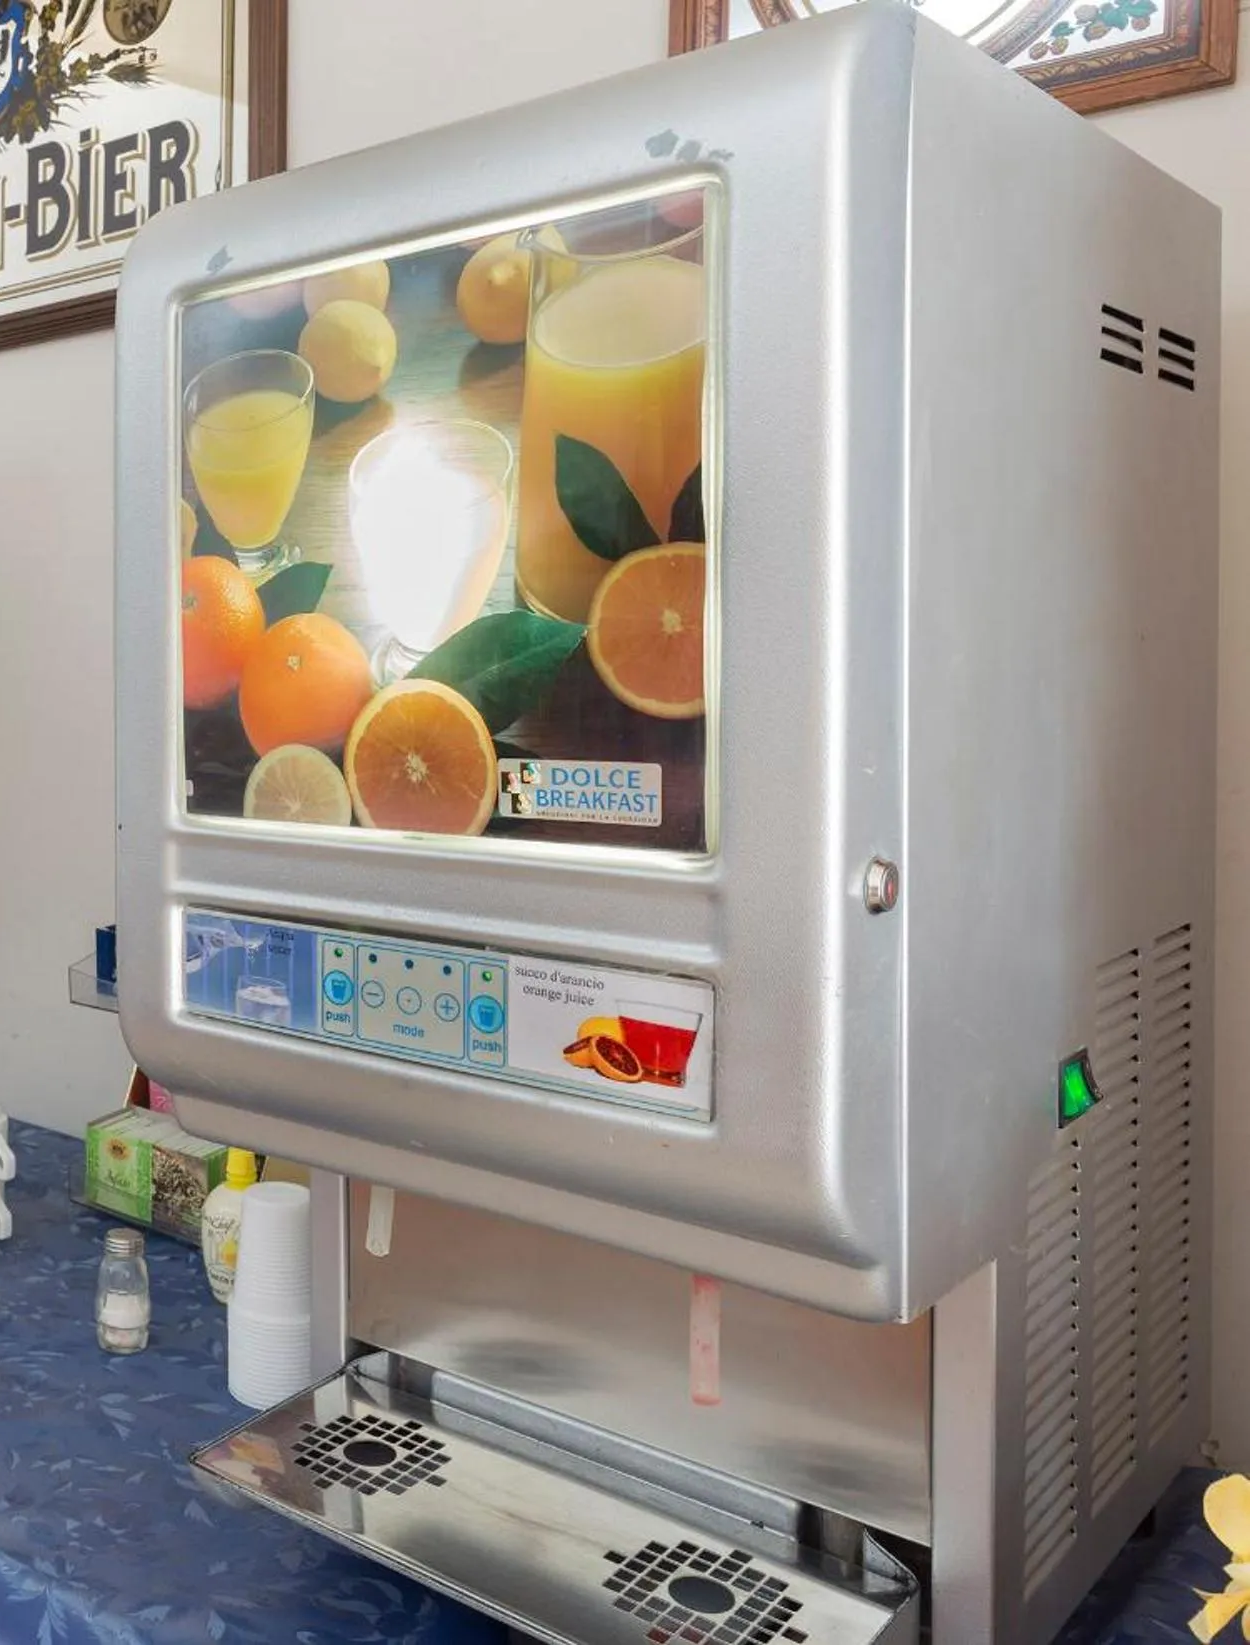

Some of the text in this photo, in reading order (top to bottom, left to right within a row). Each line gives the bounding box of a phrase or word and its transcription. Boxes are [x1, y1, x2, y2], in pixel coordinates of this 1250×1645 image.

[551, 768, 642, 789] DOLCE
[536, 789, 657, 813] BREAKFAST
[549, 969, 605, 991] d'arancio
[522, 984, 595, 1006] orange juice
[325, 1009, 351, 1024] push
[392, 1022, 425, 1038] mode
[472, 1037, 502, 1054] push
